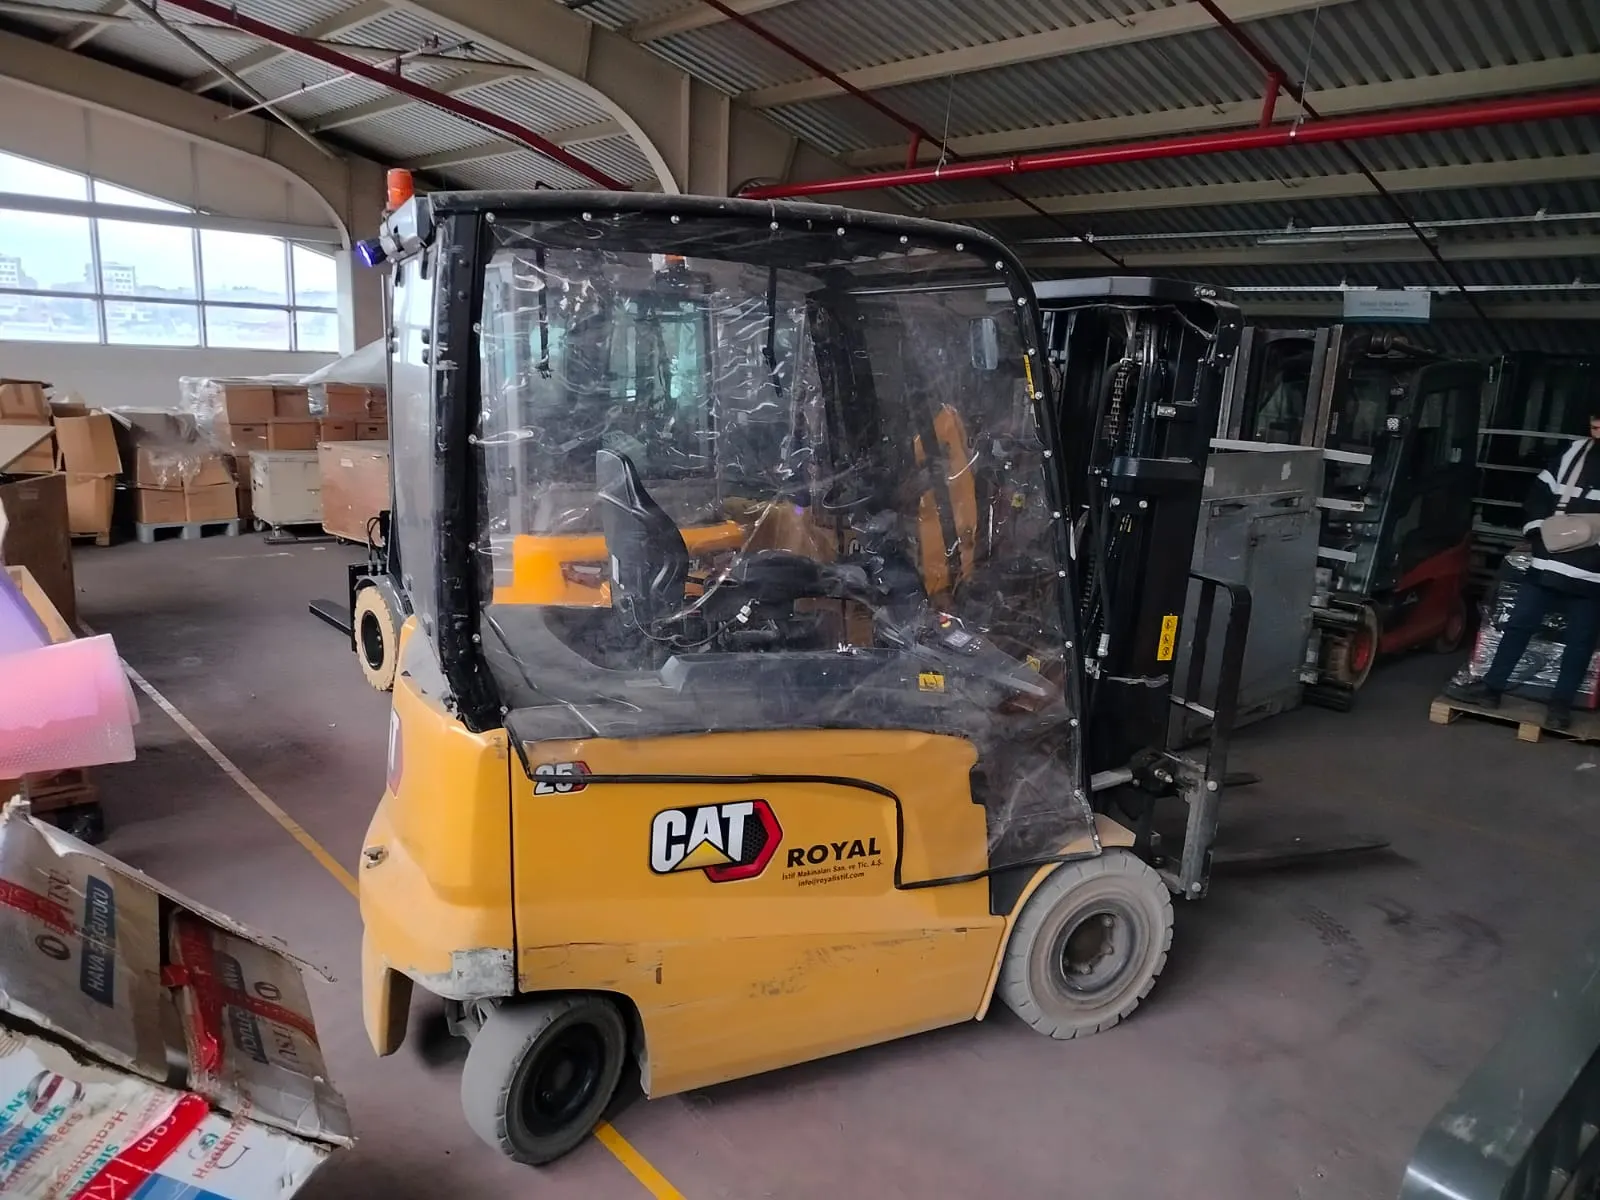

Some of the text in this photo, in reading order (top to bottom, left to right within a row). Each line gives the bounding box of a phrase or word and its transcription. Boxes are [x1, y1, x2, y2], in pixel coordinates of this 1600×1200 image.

[534, 762, 574, 795] 25
[651, 801, 754, 873] CAT
[787, 837, 881, 868] ROYAL
[87, 954, 106, 992] HAVA
